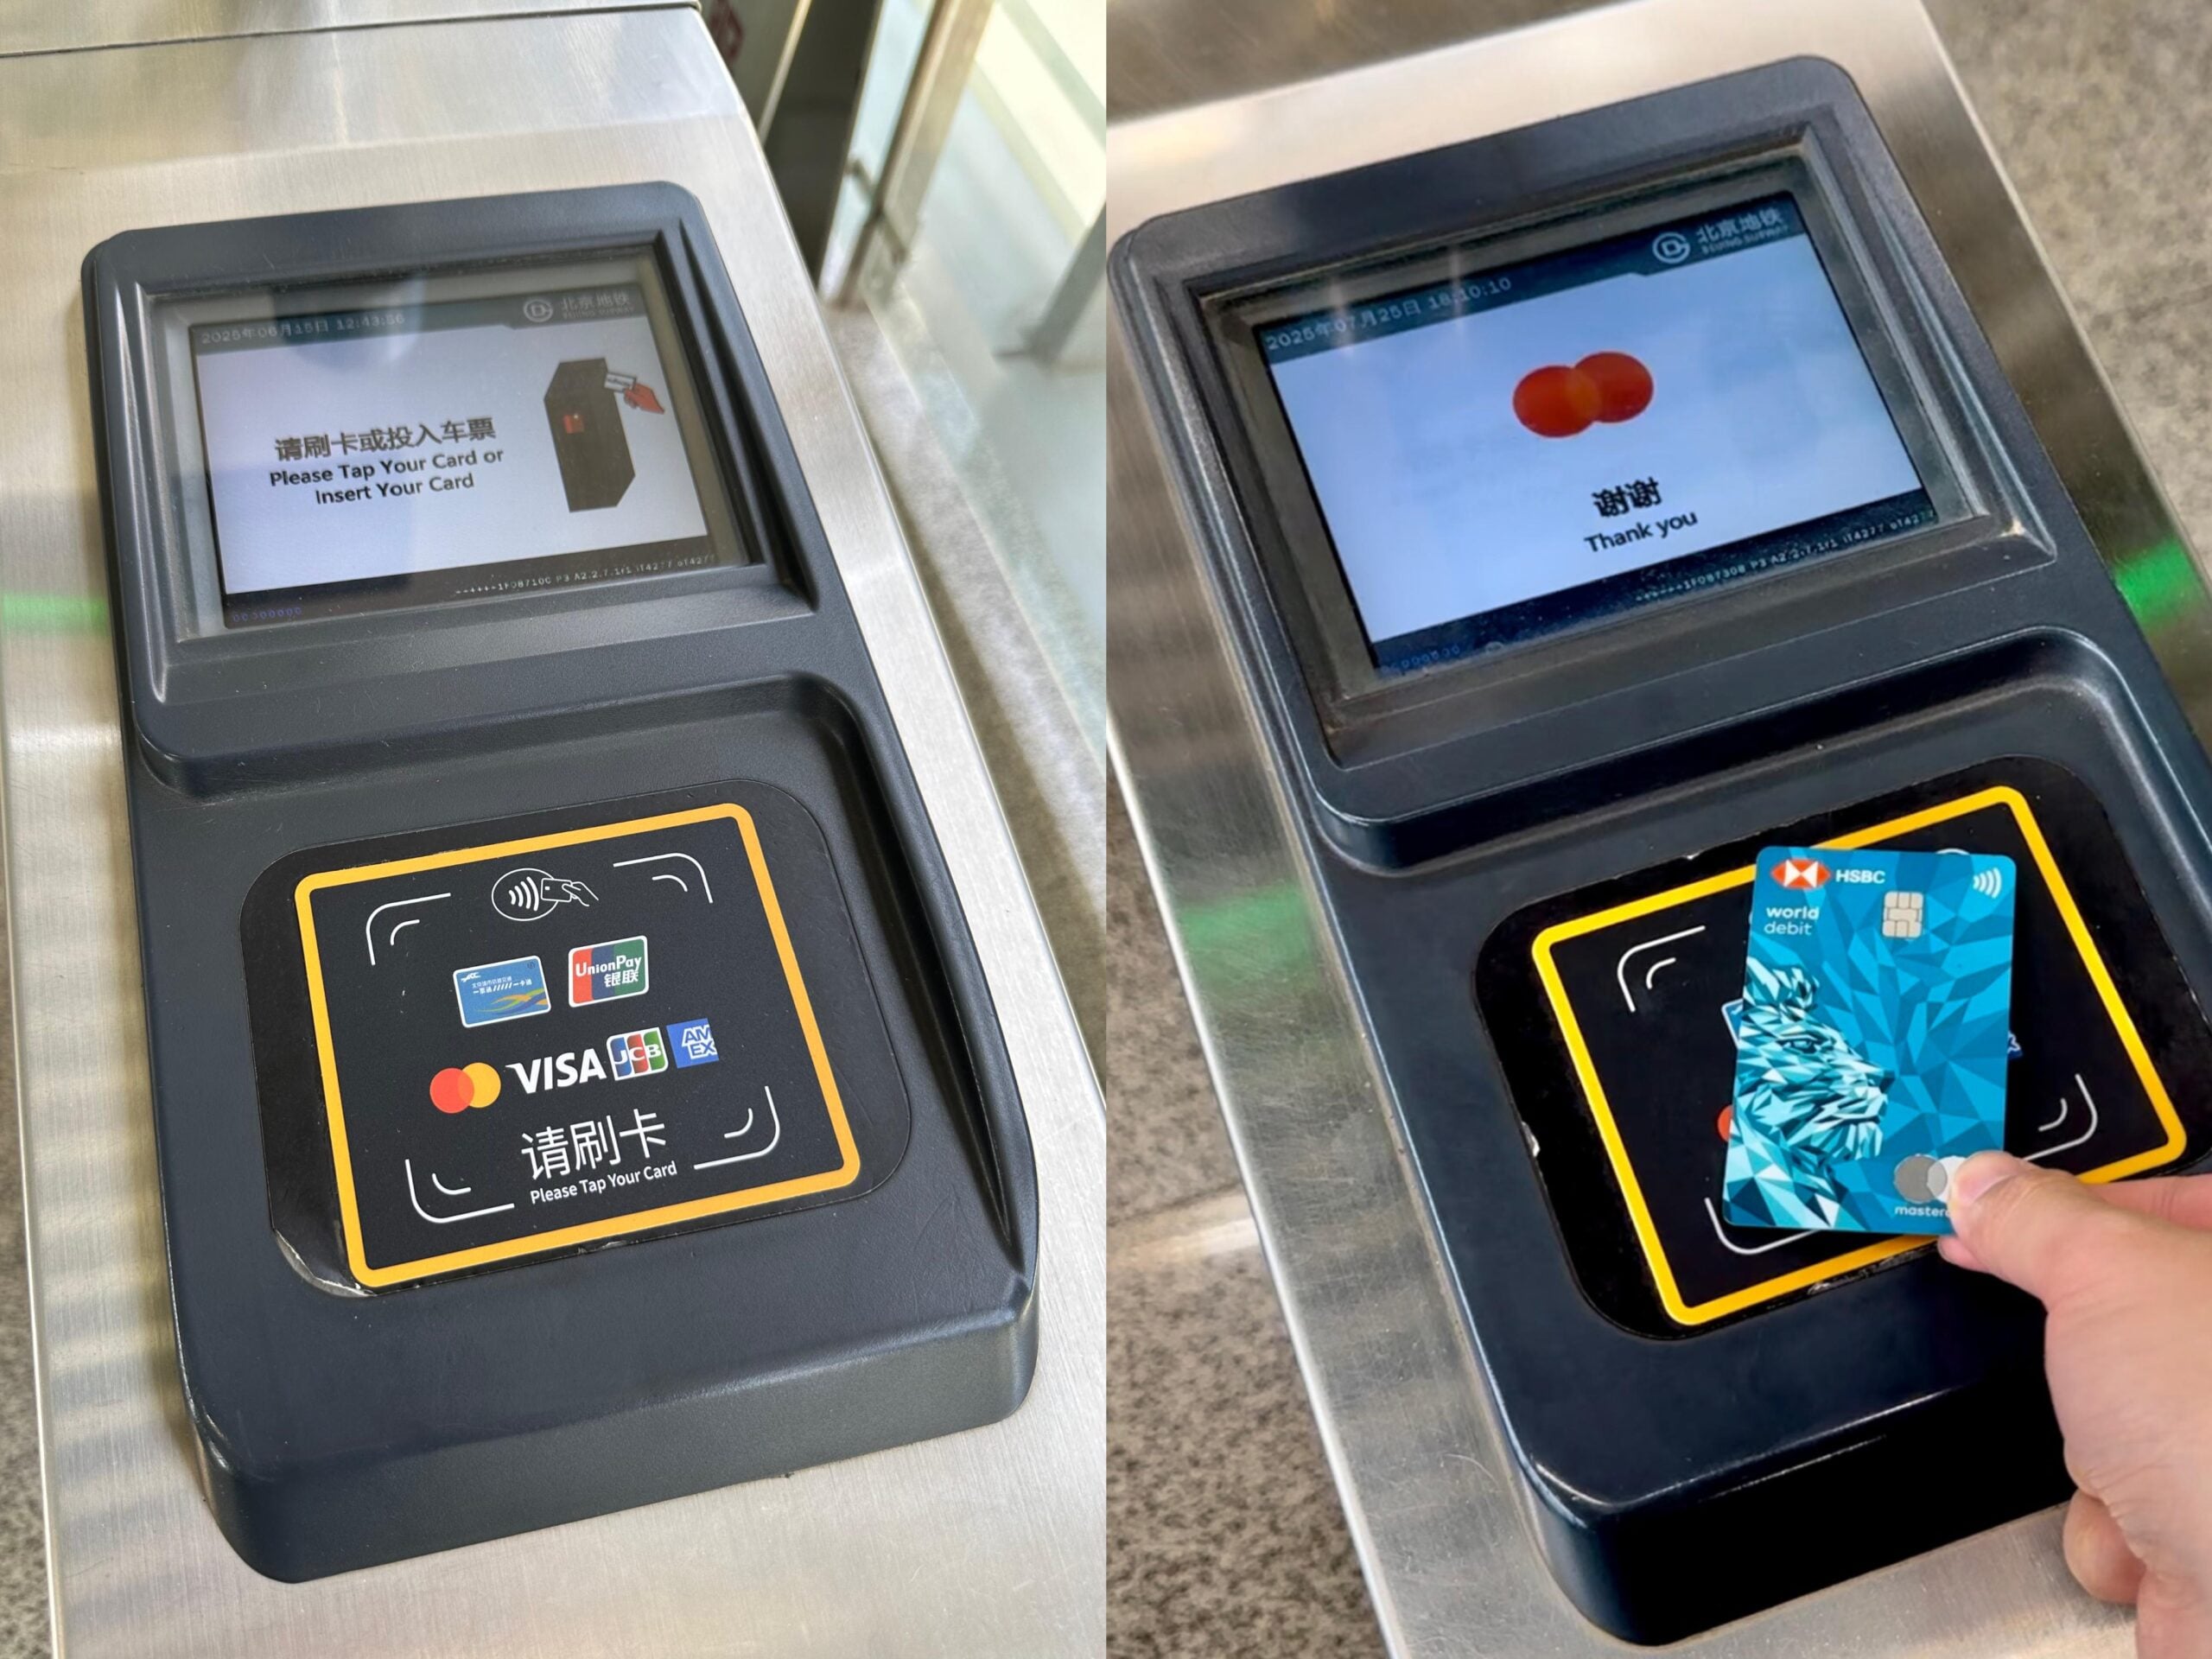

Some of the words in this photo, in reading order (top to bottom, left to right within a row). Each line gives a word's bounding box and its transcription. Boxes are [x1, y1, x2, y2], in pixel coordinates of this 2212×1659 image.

[275, 416, 497, 461] 请刷卡或投入车票
[270, 470, 334, 486] Please
[338, 464, 375, 481] Tap
[380, 458, 427, 474] Your
[432, 450, 478, 469] Card
[483, 448, 504, 463] or
[315, 486, 372, 505] Insert
[376, 480, 423, 498] Your
[429, 473, 474, 493] Card
[1592, 476, 1662, 518] 谢谢
[1584, 522, 1653, 553] Thank
[1656, 512, 1698, 539] you
[1835, 868, 1886, 884] HSBC
[1764, 921, 1812, 935] debit
[1765, 906, 1820, 919] world
[575, 954, 642, 977] UnionPay
[604, 969, 639, 988] 银联
[613, 1043, 662, 1065] JCB
[505, 1048, 607, 1094] VISA
[521, 1109, 666, 1180] 请刷卡
[530, 1184, 578, 1205] Please
[579, 1178, 606, 1194] Tap
[607, 1171, 641, 1187] Your
[643, 1160, 677, 1180] Card
[1894, 1206, 1949, 1217] masterc
